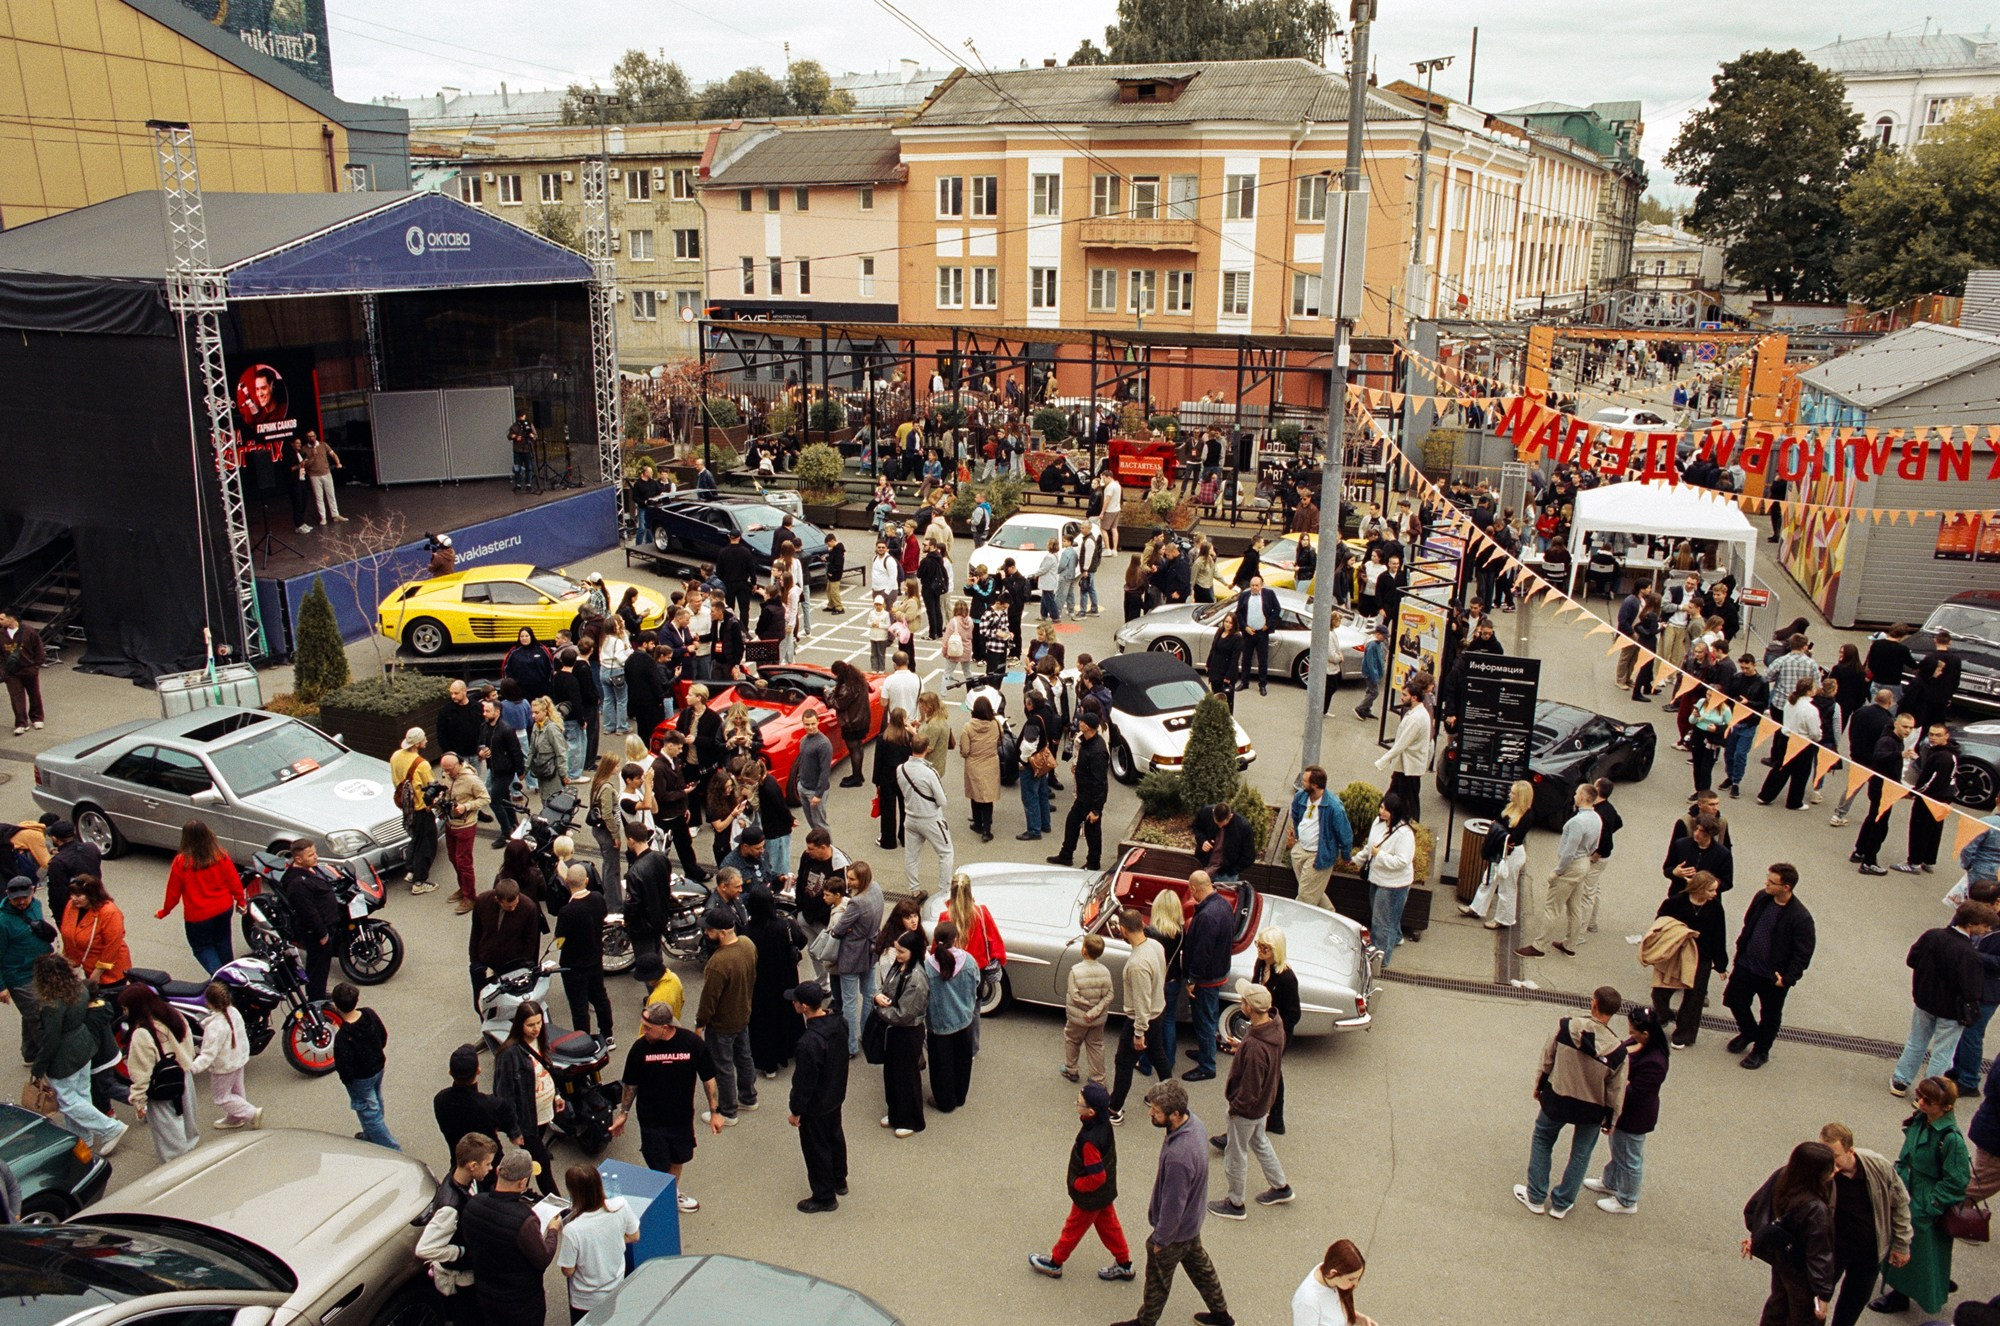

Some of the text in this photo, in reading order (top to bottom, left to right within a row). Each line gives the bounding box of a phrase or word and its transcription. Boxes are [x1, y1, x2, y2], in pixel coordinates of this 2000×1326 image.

[454, 535, 522, 565] avaklaster.ru
[1469, 660, 1525, 675] Информация
[645, 1052, 691, 1062] MINIMALISM
